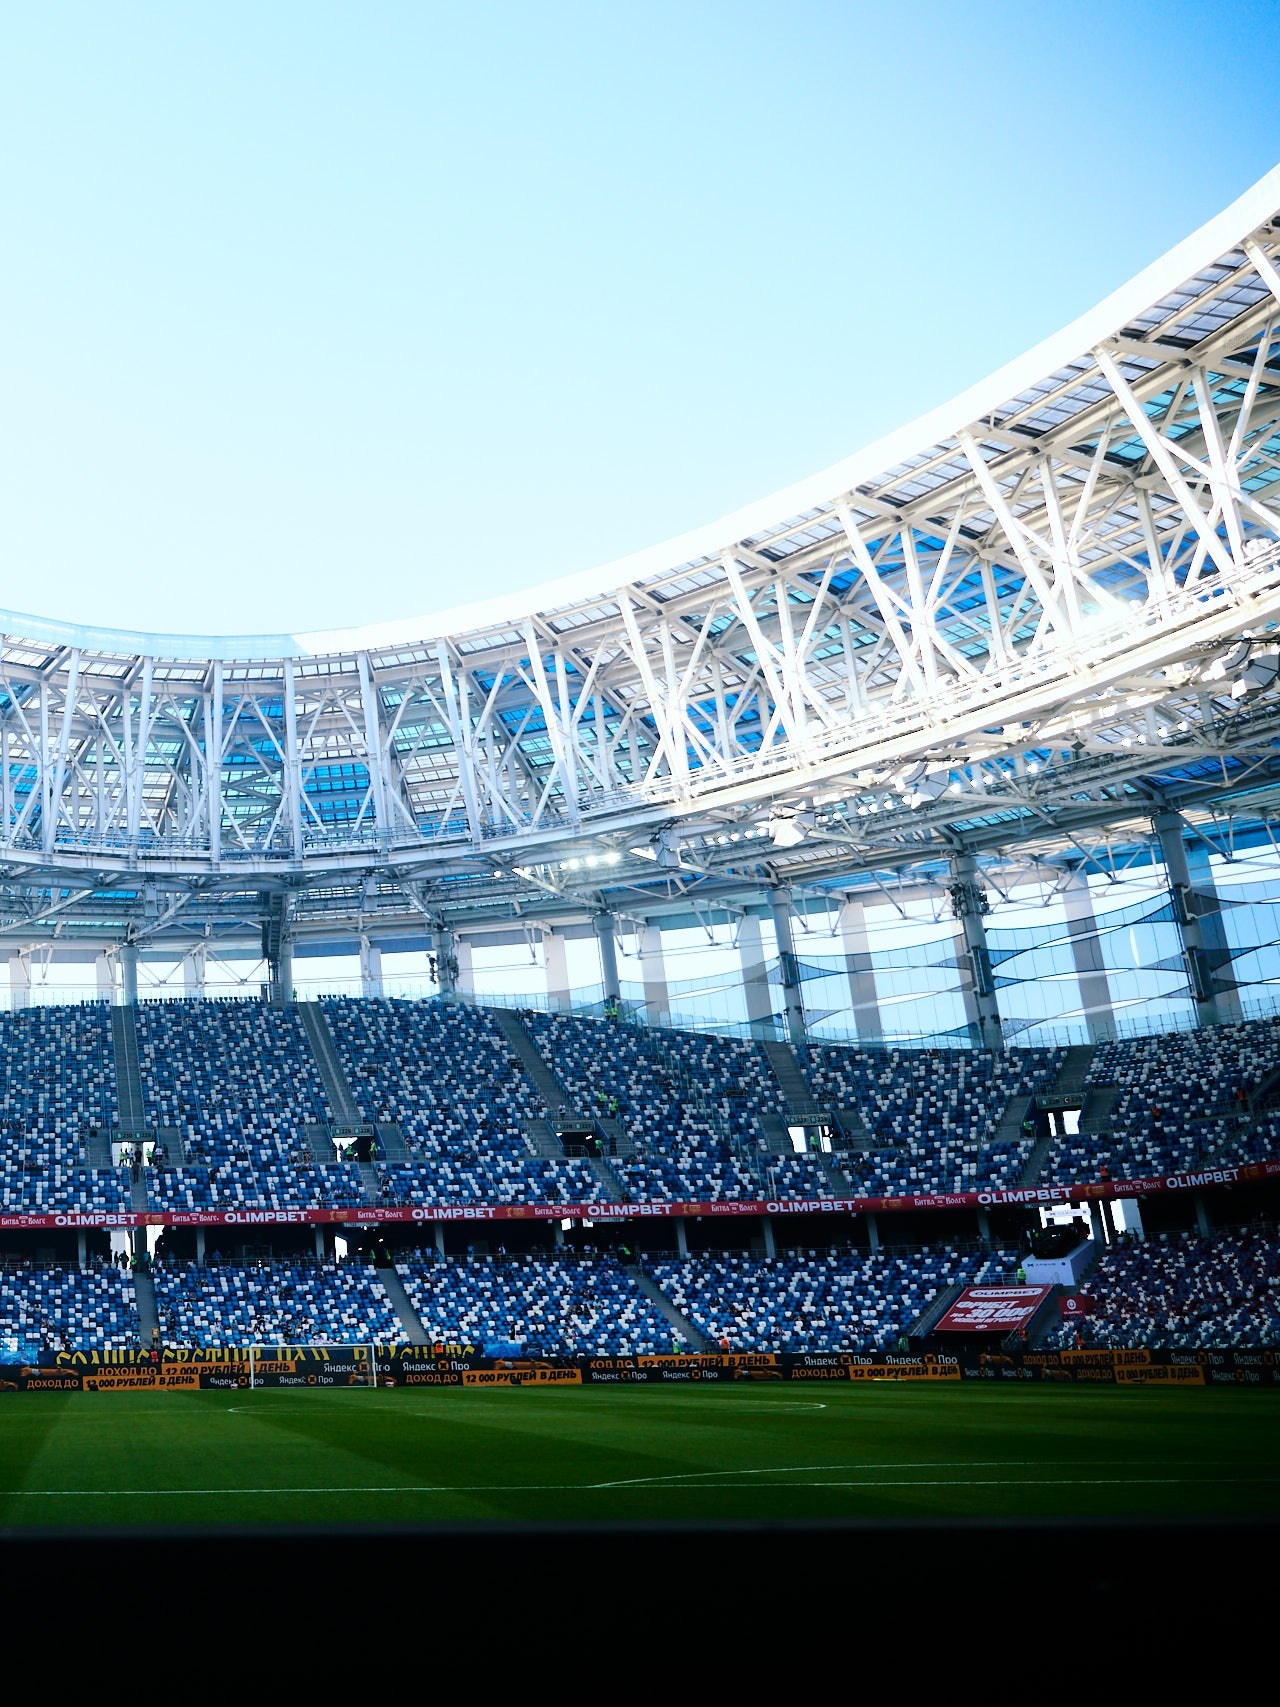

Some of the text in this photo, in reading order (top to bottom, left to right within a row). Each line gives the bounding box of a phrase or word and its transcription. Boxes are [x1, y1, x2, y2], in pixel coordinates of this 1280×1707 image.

[1166, 1168, 1239, 1189] OLIMPBET
[977, 1187, 1073, 1204] OLIMPBET
[587, 1204, 673, 1216] OLIMPBET
[766, 1200, 856, 1213] OLIMPBET
[224, 1211, 308, 1223] OLIMPBET
[411, 1207, 496, 1220] OLIMPBET
[54, 1214, 138, 1226] OLIMPBET
[402, 1361, 470, 1371] Яндекс Про
[738, 1355, 770, 1367] ДЕНЬ
[804, 1355, 873, 1366] Яндекс Про
[886, 1355, 958, 1365] Яндекс Про
[200, 1361, 245, 1374] РУБЛЕЙ
[259, 1362, 290, 1374] ДЕНЬ
[323, 1362, 357, 1373] Яндекс
[791, 1368, 829, 1379] ДОХОД
[829, 1368, 845, 1379] ДО
[852, 1368, 865, 1378] 12
[867, 1368, 885, 1377] 000
[886, 1365, 928, 1376] РУБЛЕЙ
[931, 1366, 938, 1375] В
[1177, 1367, 1201, 1380] ДЕНЬ
[278, 1375, 334, 1385] Яндекс Про
[405, 1370, 577, 1384] ДОХОД ДО 12 000 РУБЛЕЙ В ДЕНЬ
[591, 1371, 648, 1381] Яндекс Про
[662, 1370, 718, 1380] Яндекс Про
[26, 1379, 63, 1390] ДОХОД
[63, 1379, 79, 1389] ДО
[98, 1378, 115, 1388] 000
[116, 1374, 156, 1387] РУБЛЕЙ
[159, 1376, 166, 1385] В
[167, 1375, 195, 1387] ДЕНЬ
